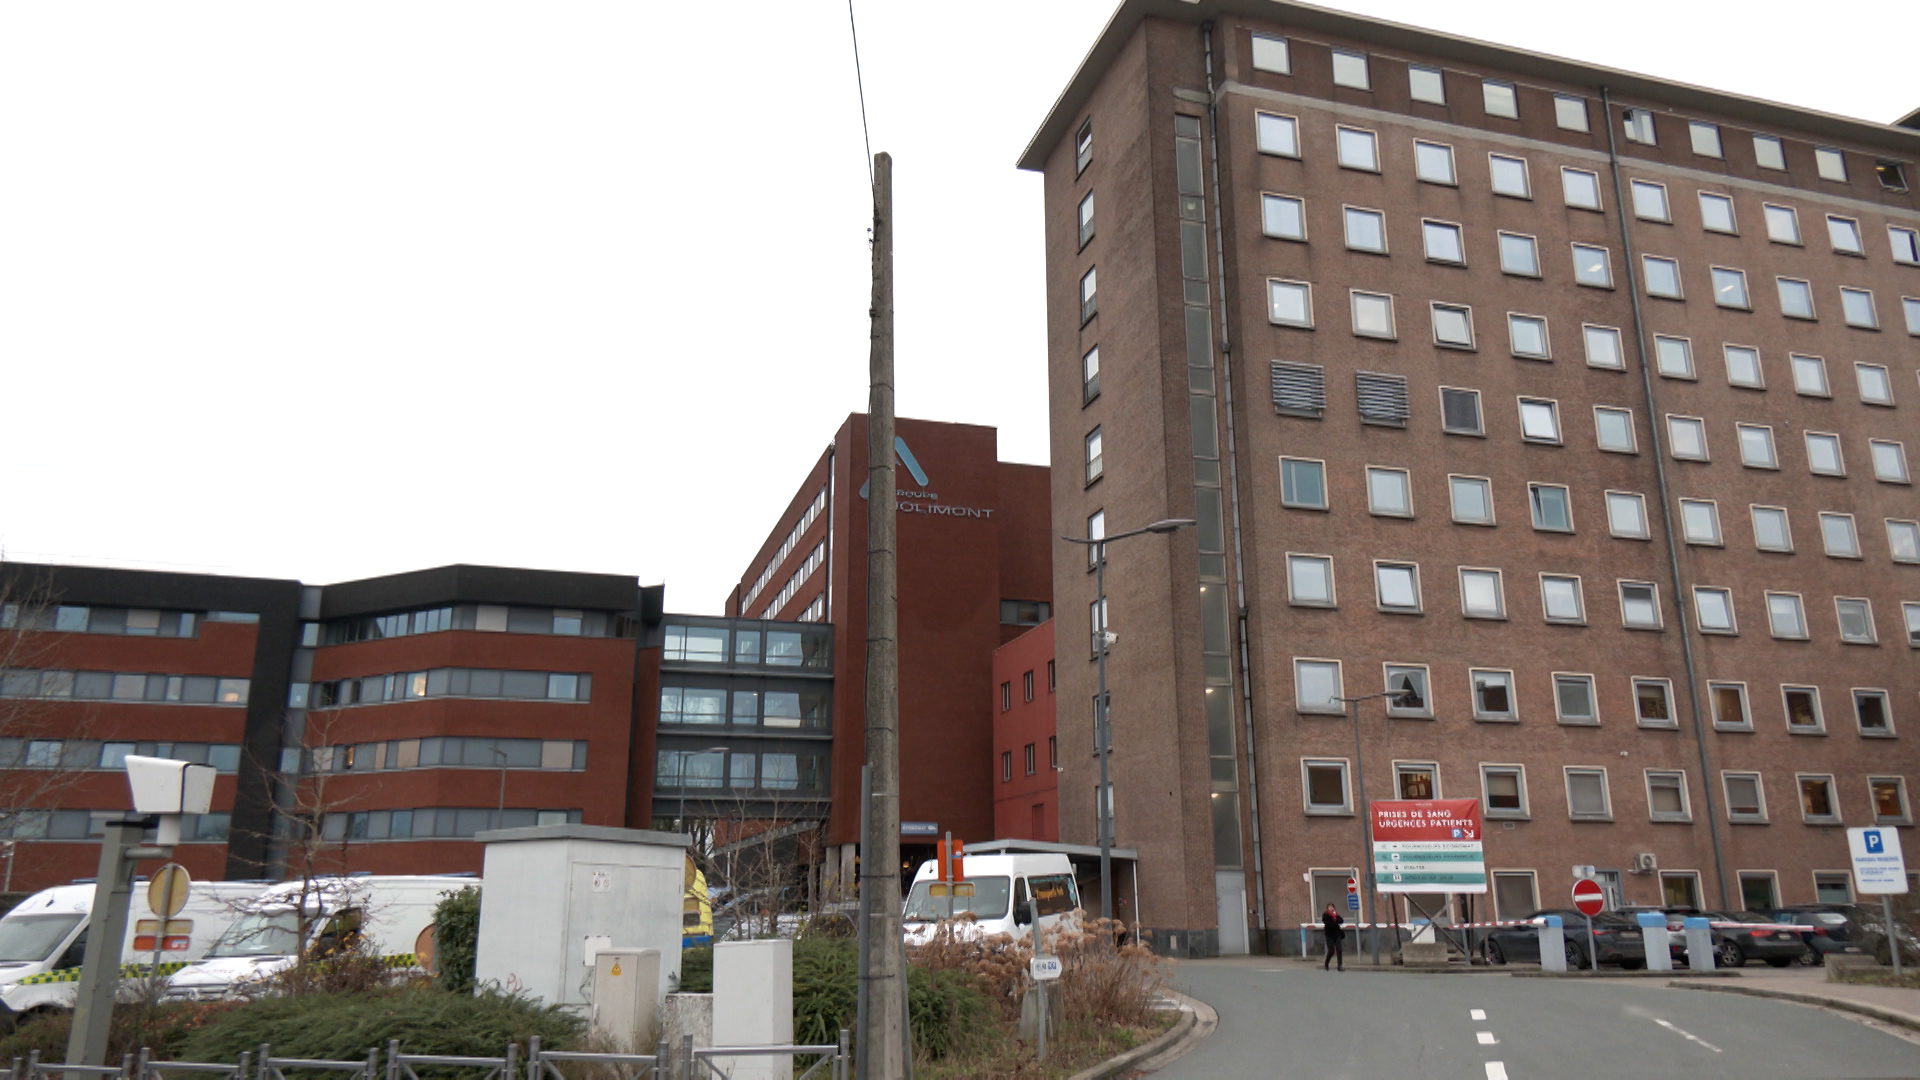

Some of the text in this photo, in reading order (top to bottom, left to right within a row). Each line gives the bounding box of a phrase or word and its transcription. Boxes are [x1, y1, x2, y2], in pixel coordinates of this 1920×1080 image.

[896, 489, 938, 500] ROUPE
[1378, 809, 1451, 818] PRISES DE SANG
[1378, 819, 1473, 828] URGENCES PATIENTS
[1868, 835, 1880, 848] P
